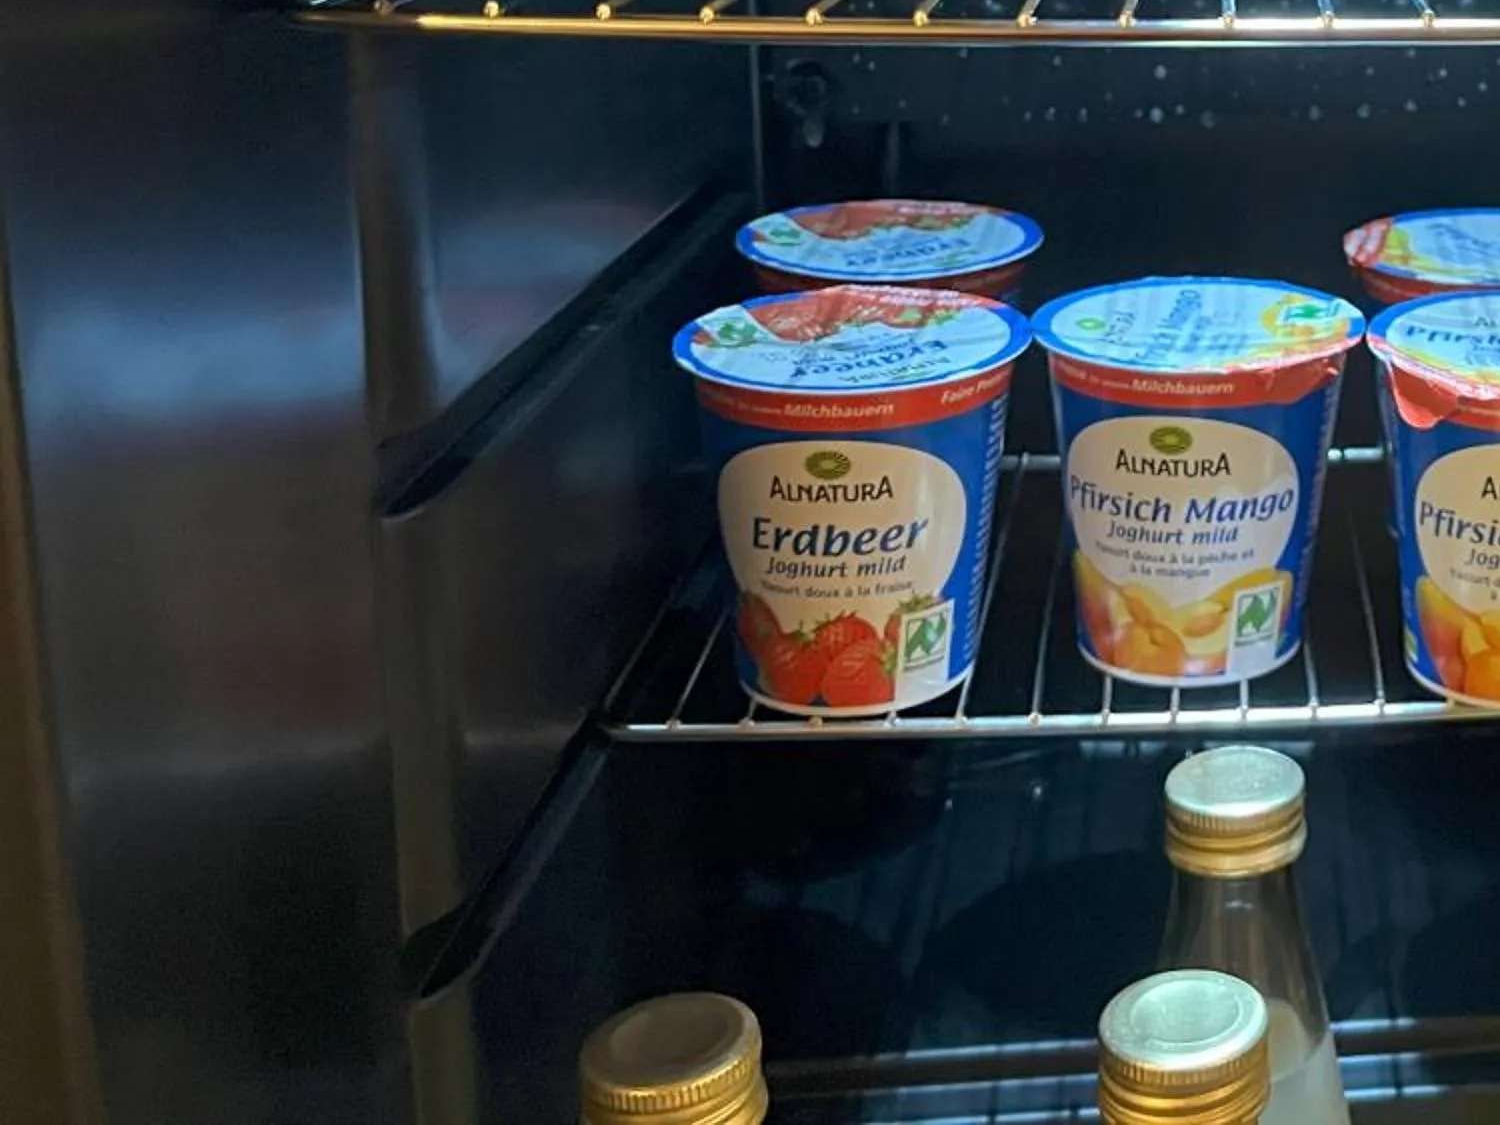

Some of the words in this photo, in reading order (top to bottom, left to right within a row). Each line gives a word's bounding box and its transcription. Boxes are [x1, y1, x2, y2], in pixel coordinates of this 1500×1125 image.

[1131, 378, 1236, 395] Milchbauern
[783, 402, 896, 420] Milchbauern
[1115, 448, 1232, 478] ALNATURA
[770, 475, 894, 504] ALNATURA
[1070, 475, 1171, 524] Pfirsich
[1185, 487, 1295, 525] Mango
[751, 516, 929, 558] Erdbeer
[1106, 521, 1184, 545] Joghurt
[1191, 525, 1239, 544] mild
[765, 556, 849, 581] Joghurt
[856, 553, 908, 577] mild
